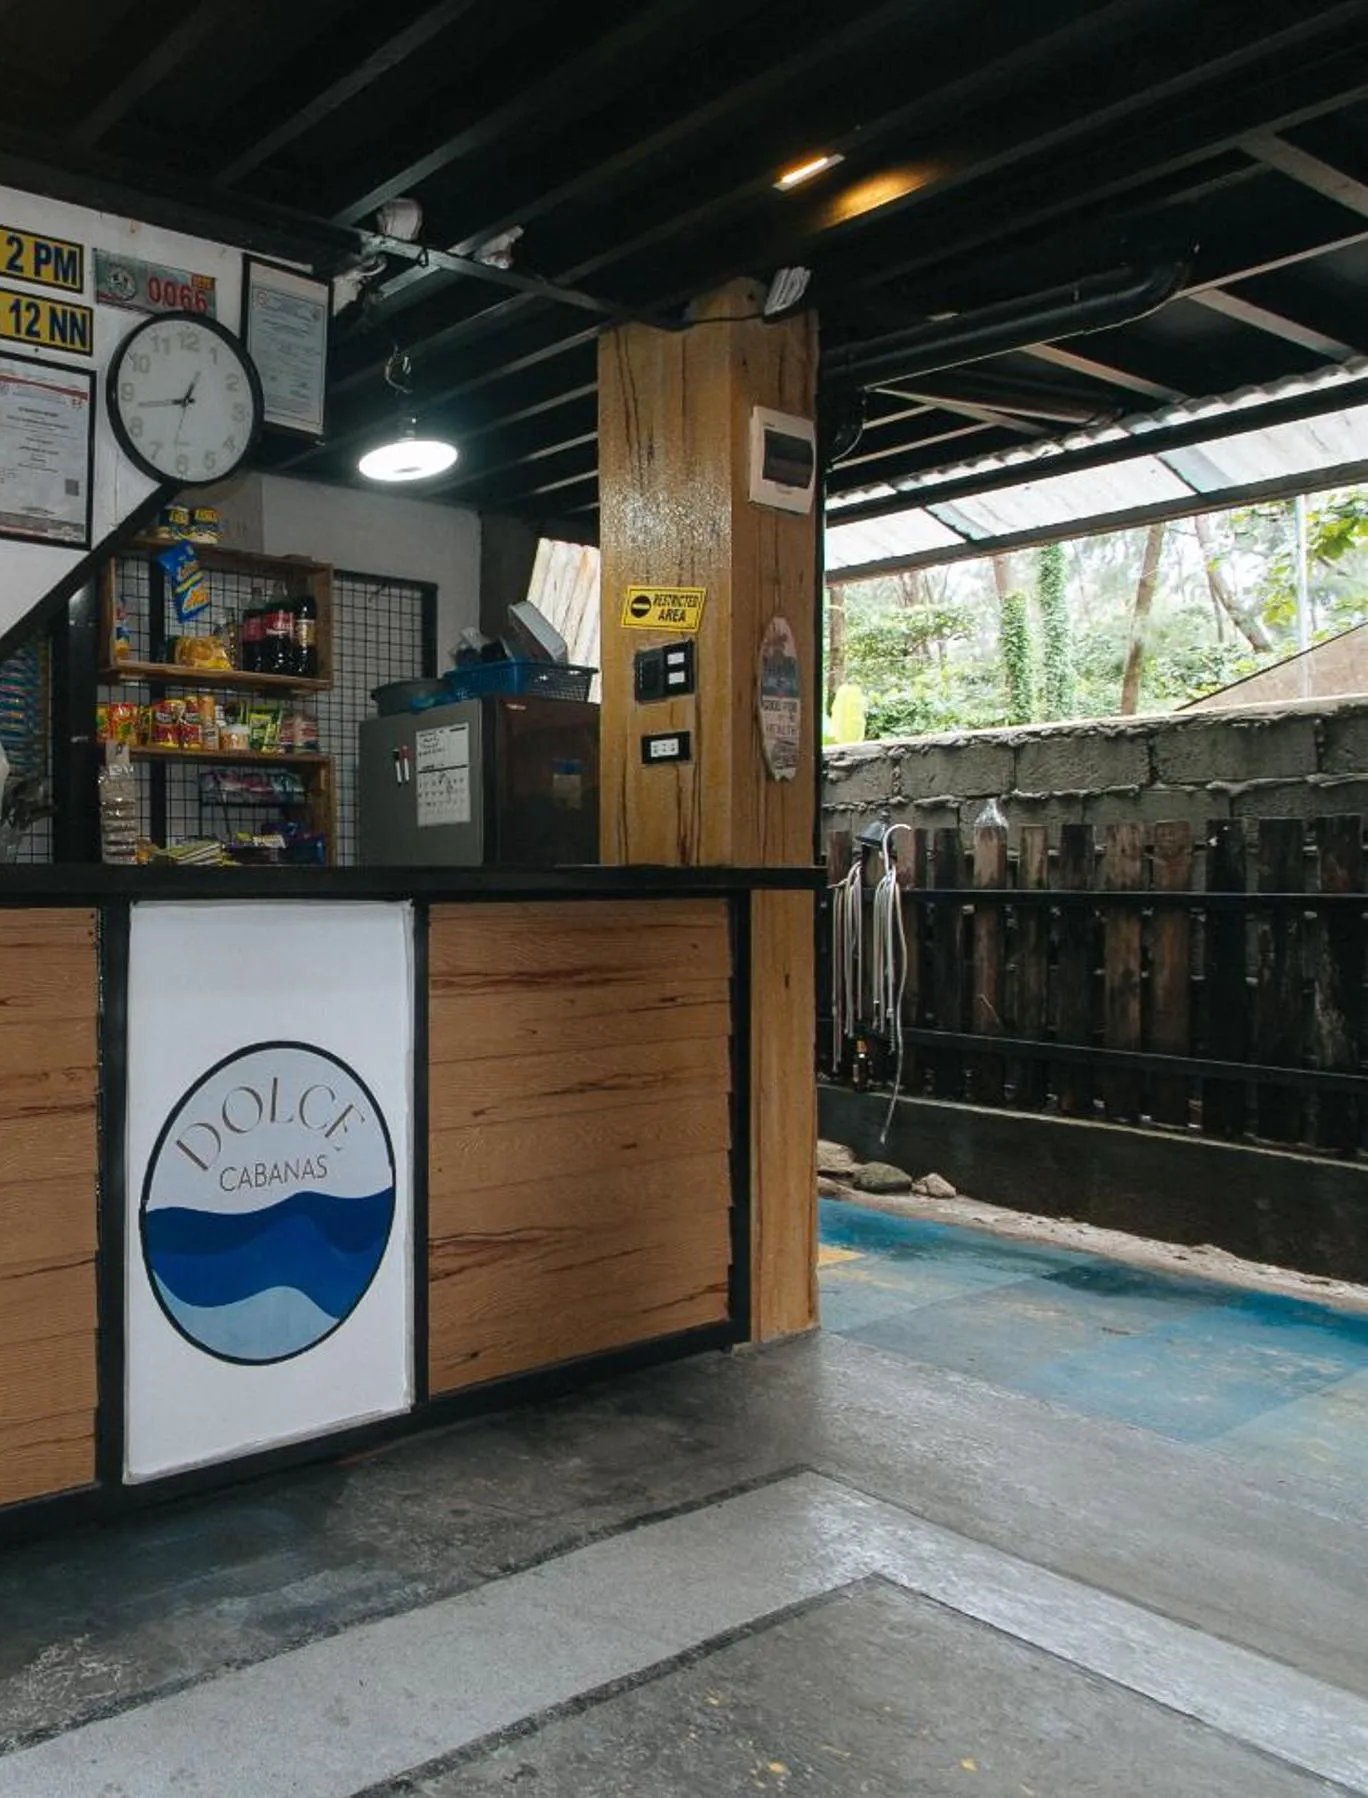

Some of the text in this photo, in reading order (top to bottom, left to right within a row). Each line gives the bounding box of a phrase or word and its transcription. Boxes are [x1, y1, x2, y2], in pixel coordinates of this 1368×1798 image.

[6, 236, 23, 273] 2
[34, 241, 78, 286] PM
[9, 299, 41, 339] 12
[49, 307, 87, 348] NN
[152, 335, 171, 354] 11
[178, 332, 200, 351] 12
[132, 353, 150, 374] 10
[120, 383, 135, 401] 9
[226, 374, 239, 392] 2
[131, 417, 144, 438] 8
[149, 442, 163, 460] 7
[205, 451, 216, 470] 5
[658, 608, 687, 622] AREA
[176, 1076, 366, 1172] DOLCE
[219, 1154, 329, 1192] CABANAS
